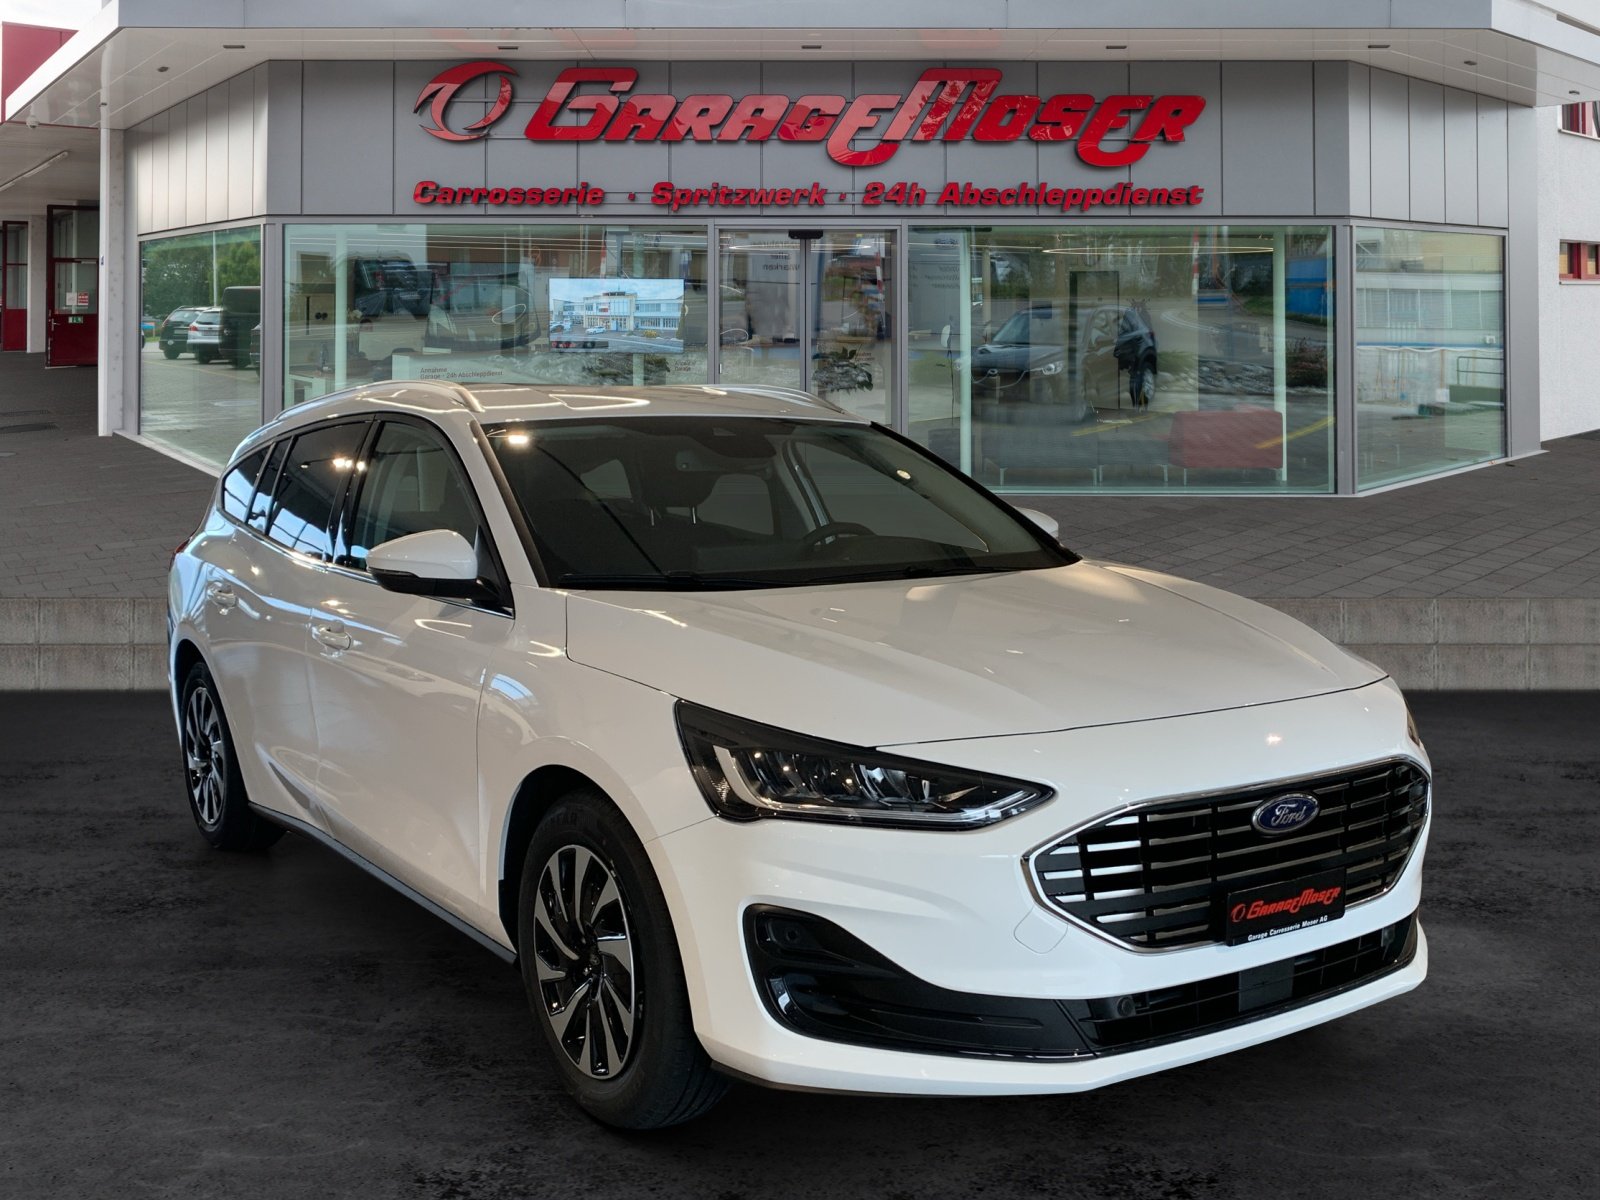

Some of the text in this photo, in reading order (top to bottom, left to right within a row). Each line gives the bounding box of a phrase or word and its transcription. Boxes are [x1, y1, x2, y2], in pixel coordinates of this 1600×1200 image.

[413, 180, 1204, 212] Carrosserie Spritzwerk 24h Abschleppdienst
[1271, 803, 1307, 826] Ford
[1247, 915, 1328, 941] Garage Carrosserie Moser AG
